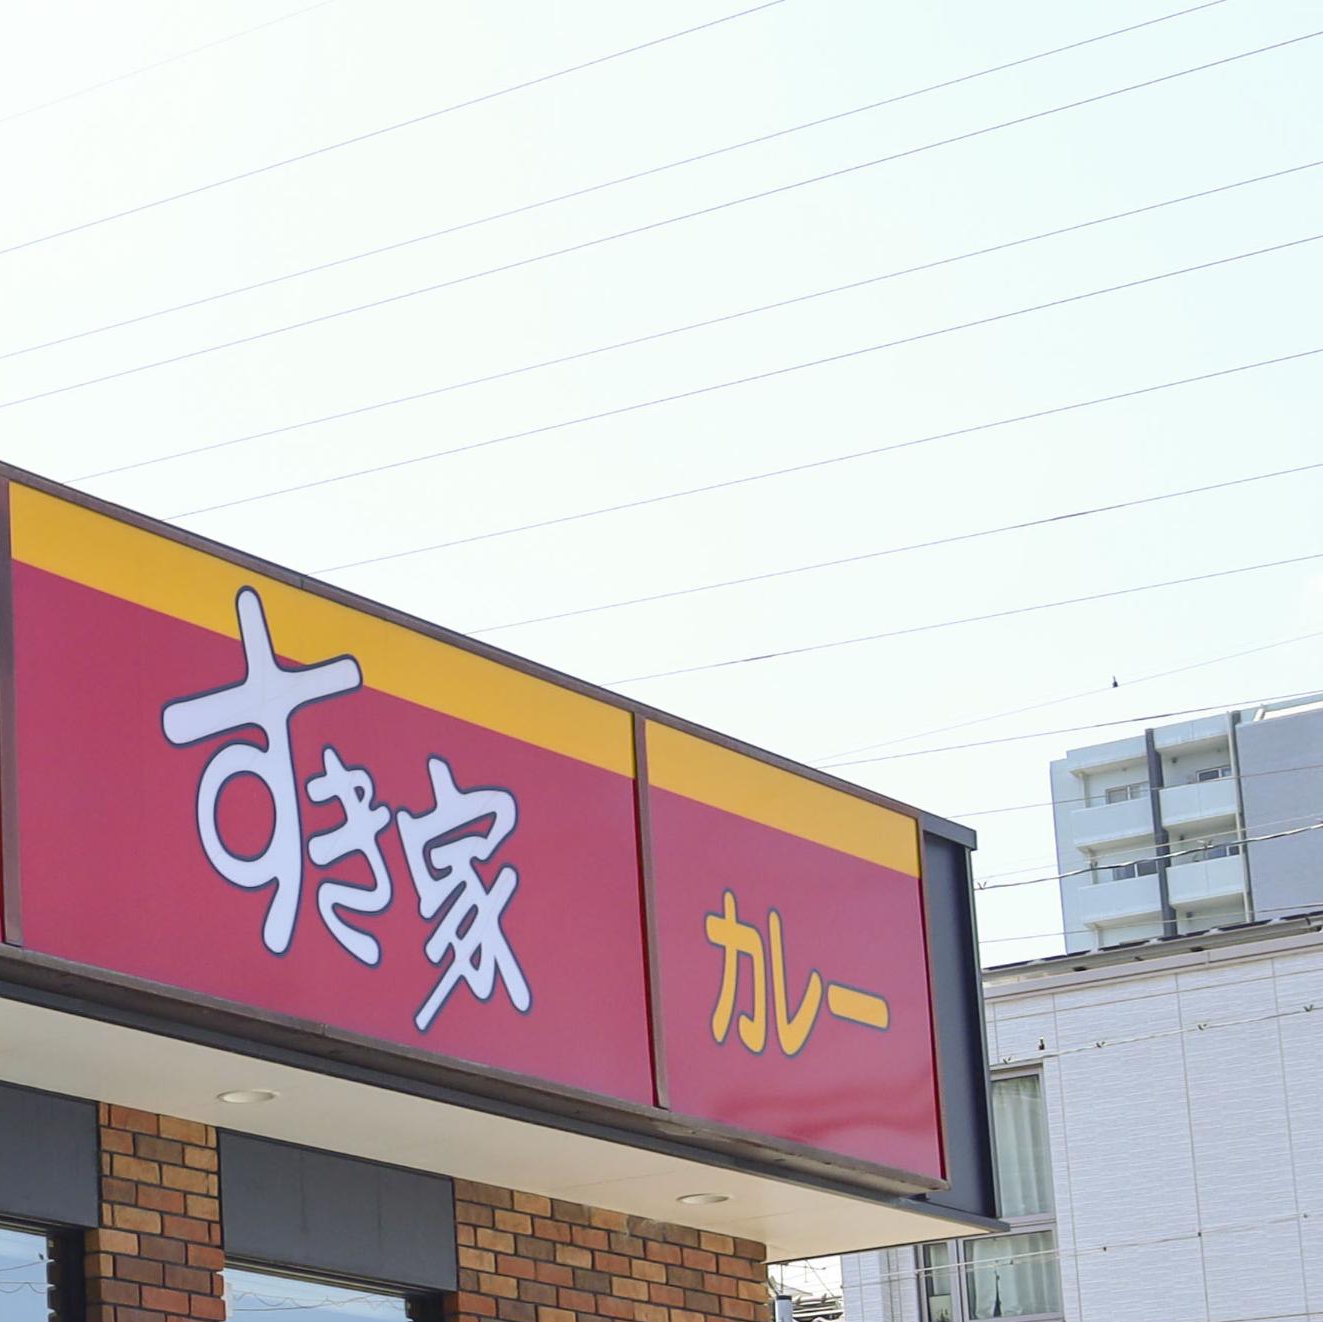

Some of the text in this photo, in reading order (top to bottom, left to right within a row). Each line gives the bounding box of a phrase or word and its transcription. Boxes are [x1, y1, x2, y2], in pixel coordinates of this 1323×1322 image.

[161, 585, 530, 1032] すき家
[705, 889, 889, 1056] カレー
